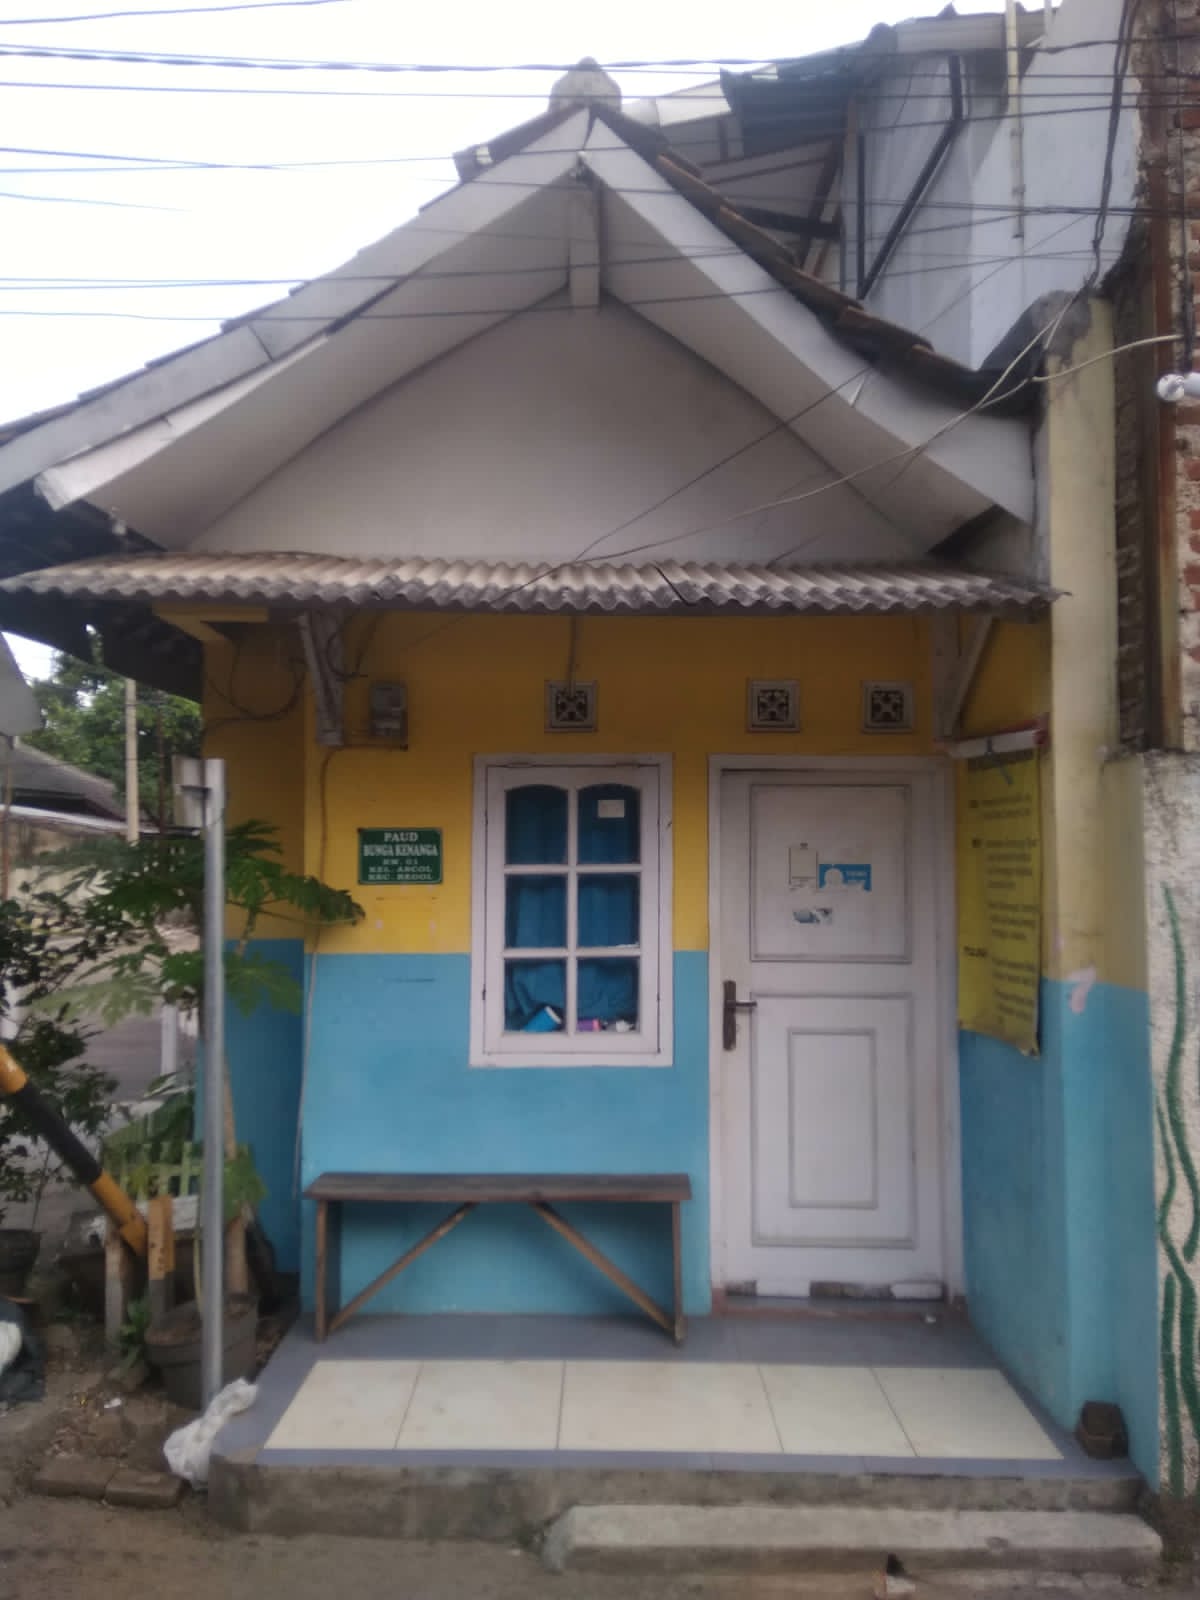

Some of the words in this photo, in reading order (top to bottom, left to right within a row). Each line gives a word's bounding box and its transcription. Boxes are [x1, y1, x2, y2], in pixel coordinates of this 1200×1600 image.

[383, 832, 419, 842] PAUD
[363, 844, 394, 857] BUNGA
[395, 844, 439, 857] KENANGA
[396, 865, 433, 873] ANCOL
